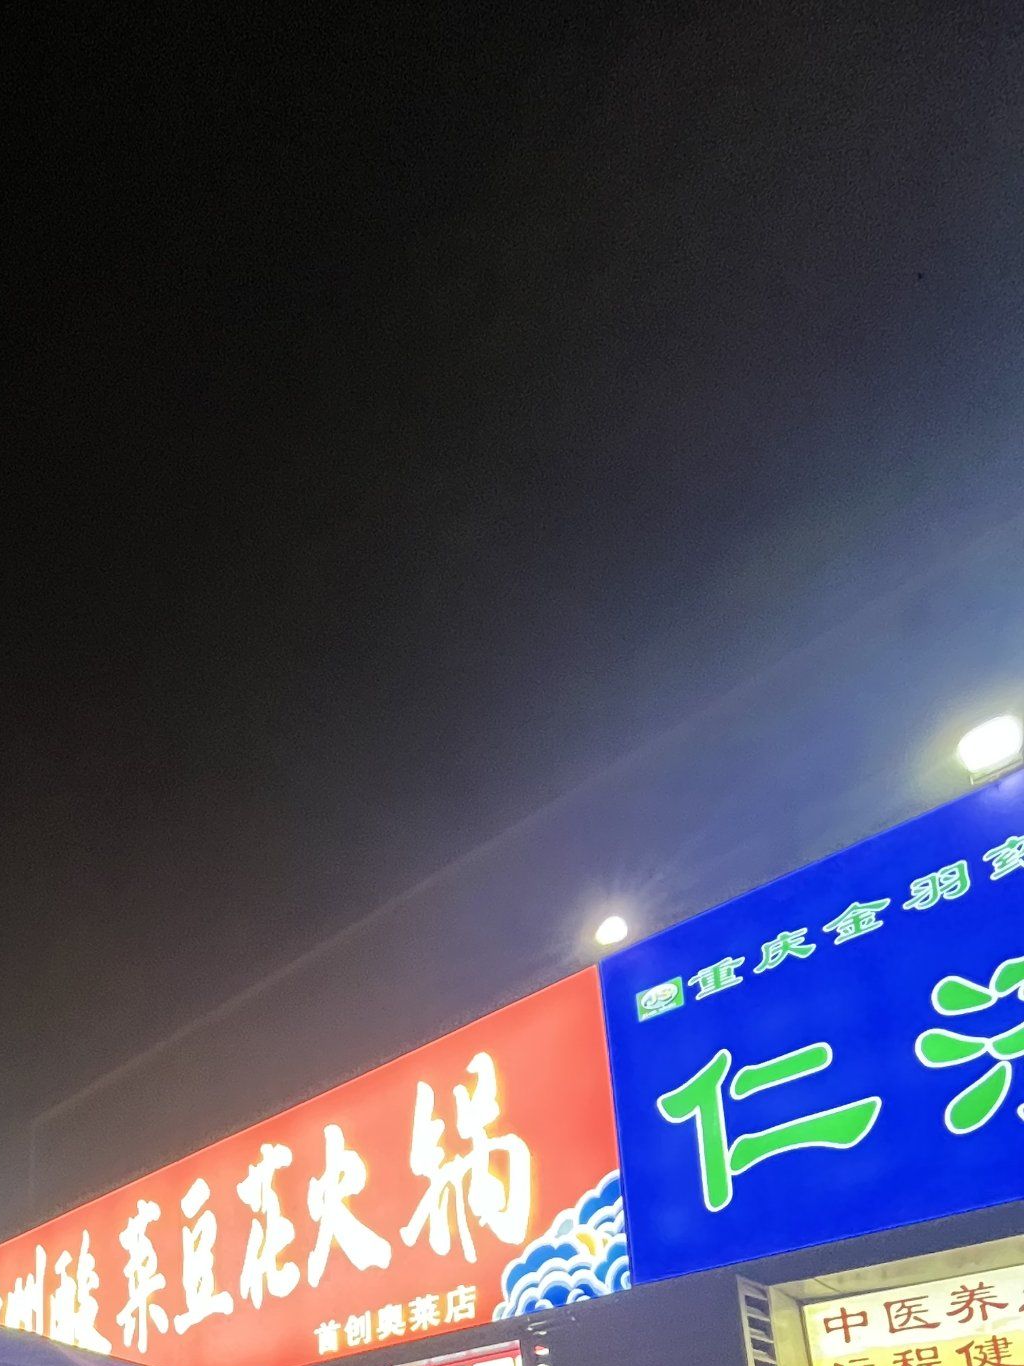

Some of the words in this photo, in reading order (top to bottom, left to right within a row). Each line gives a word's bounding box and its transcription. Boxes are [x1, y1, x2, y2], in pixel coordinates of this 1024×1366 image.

[313, 1284, 477, 1355] 首创奥莱店
[823, 1282, 1024, 1343] 中医养
